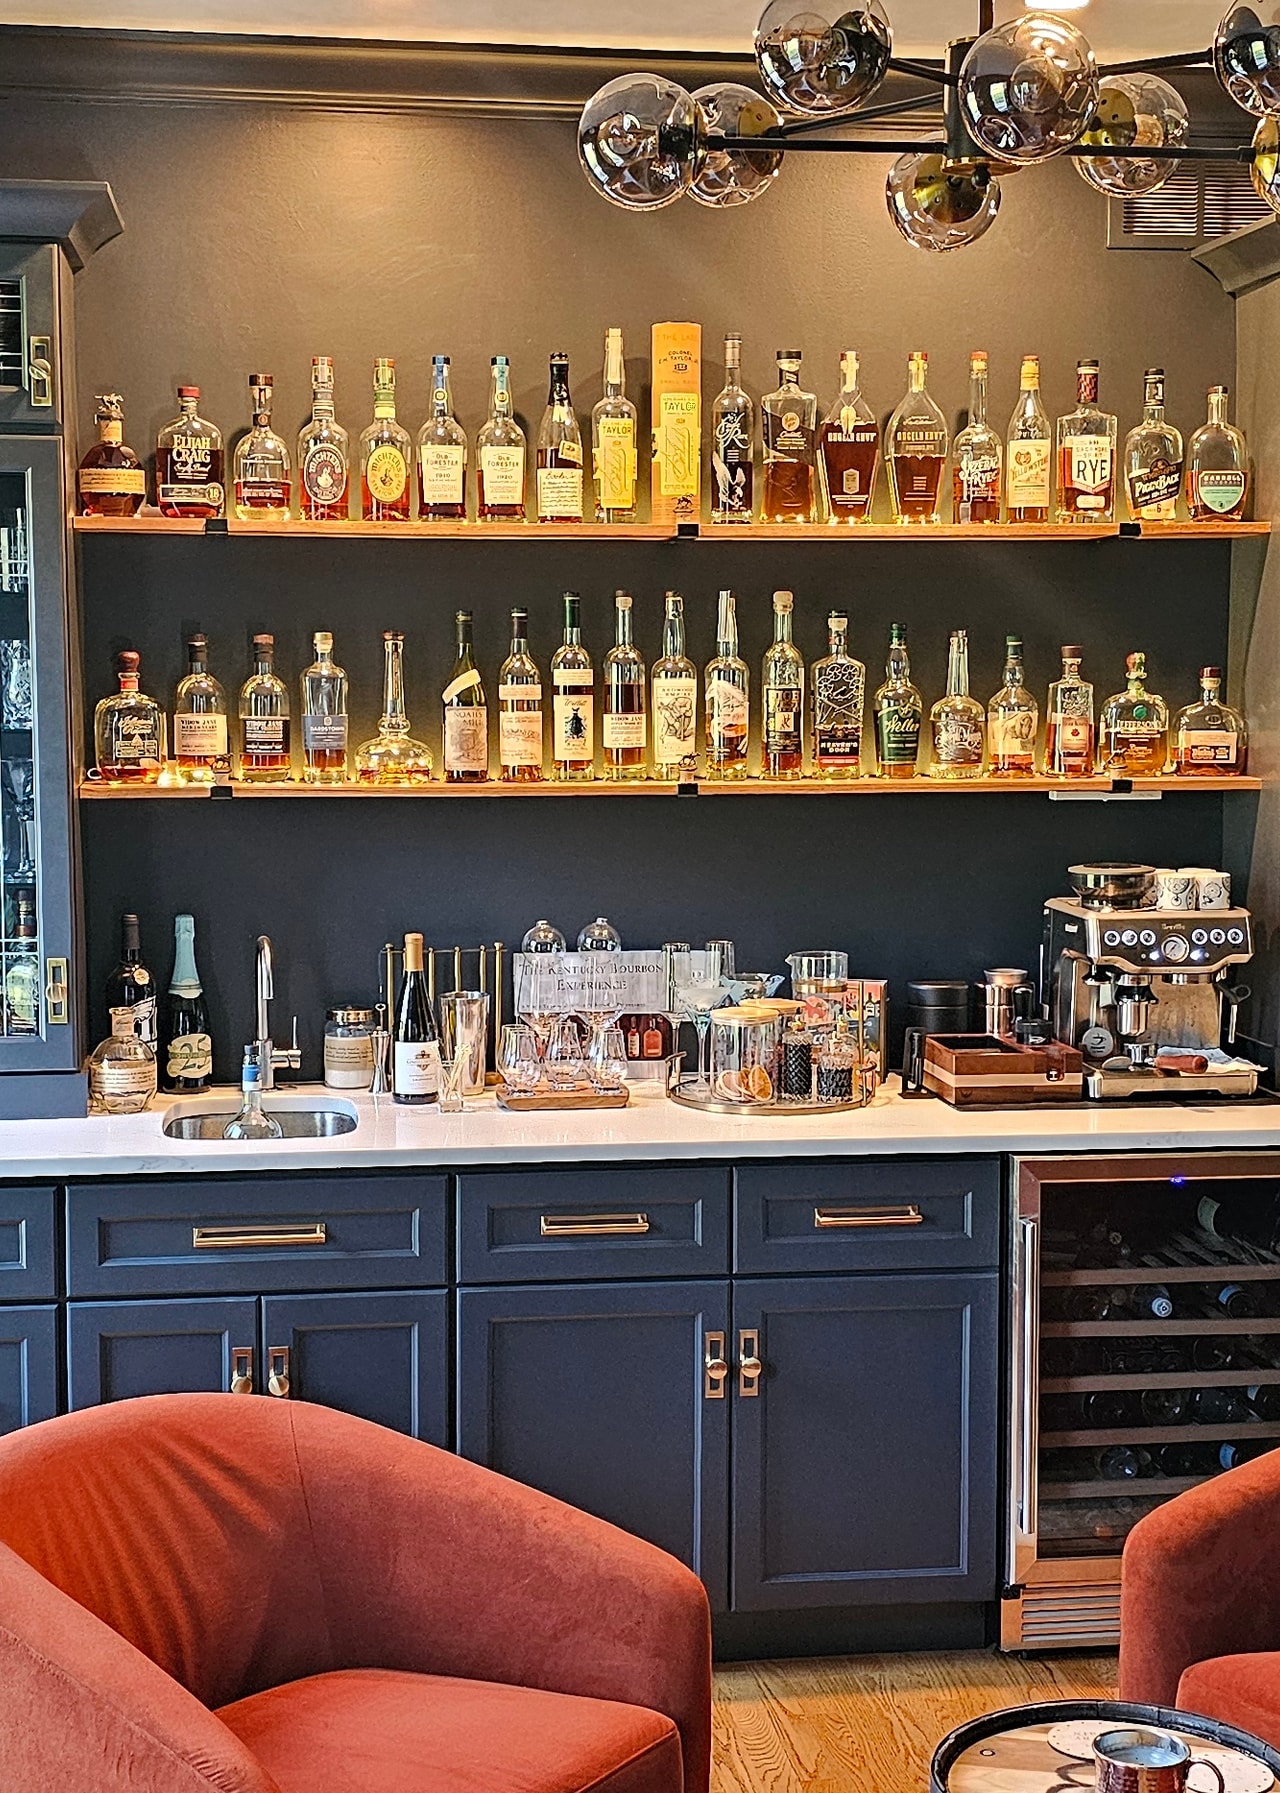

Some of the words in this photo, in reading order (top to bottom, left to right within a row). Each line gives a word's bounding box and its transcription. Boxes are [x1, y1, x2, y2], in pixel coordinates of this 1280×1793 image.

[602, 426, 632, 435] TAYLOR
[172, 434, 211, 450] ELIJAH
[172, 447, 211, 463] CRAIG
[1076, 459, 1108, 485] RYE
[1156, 503, 1162, 513] 6
[885, 714, 920, 733] Weller
[548, 963, 606, 975] KENTUCKY
[612, 962, 664, 974] BOURBON
[557, 979, 627, 991] EXPERIENCE
